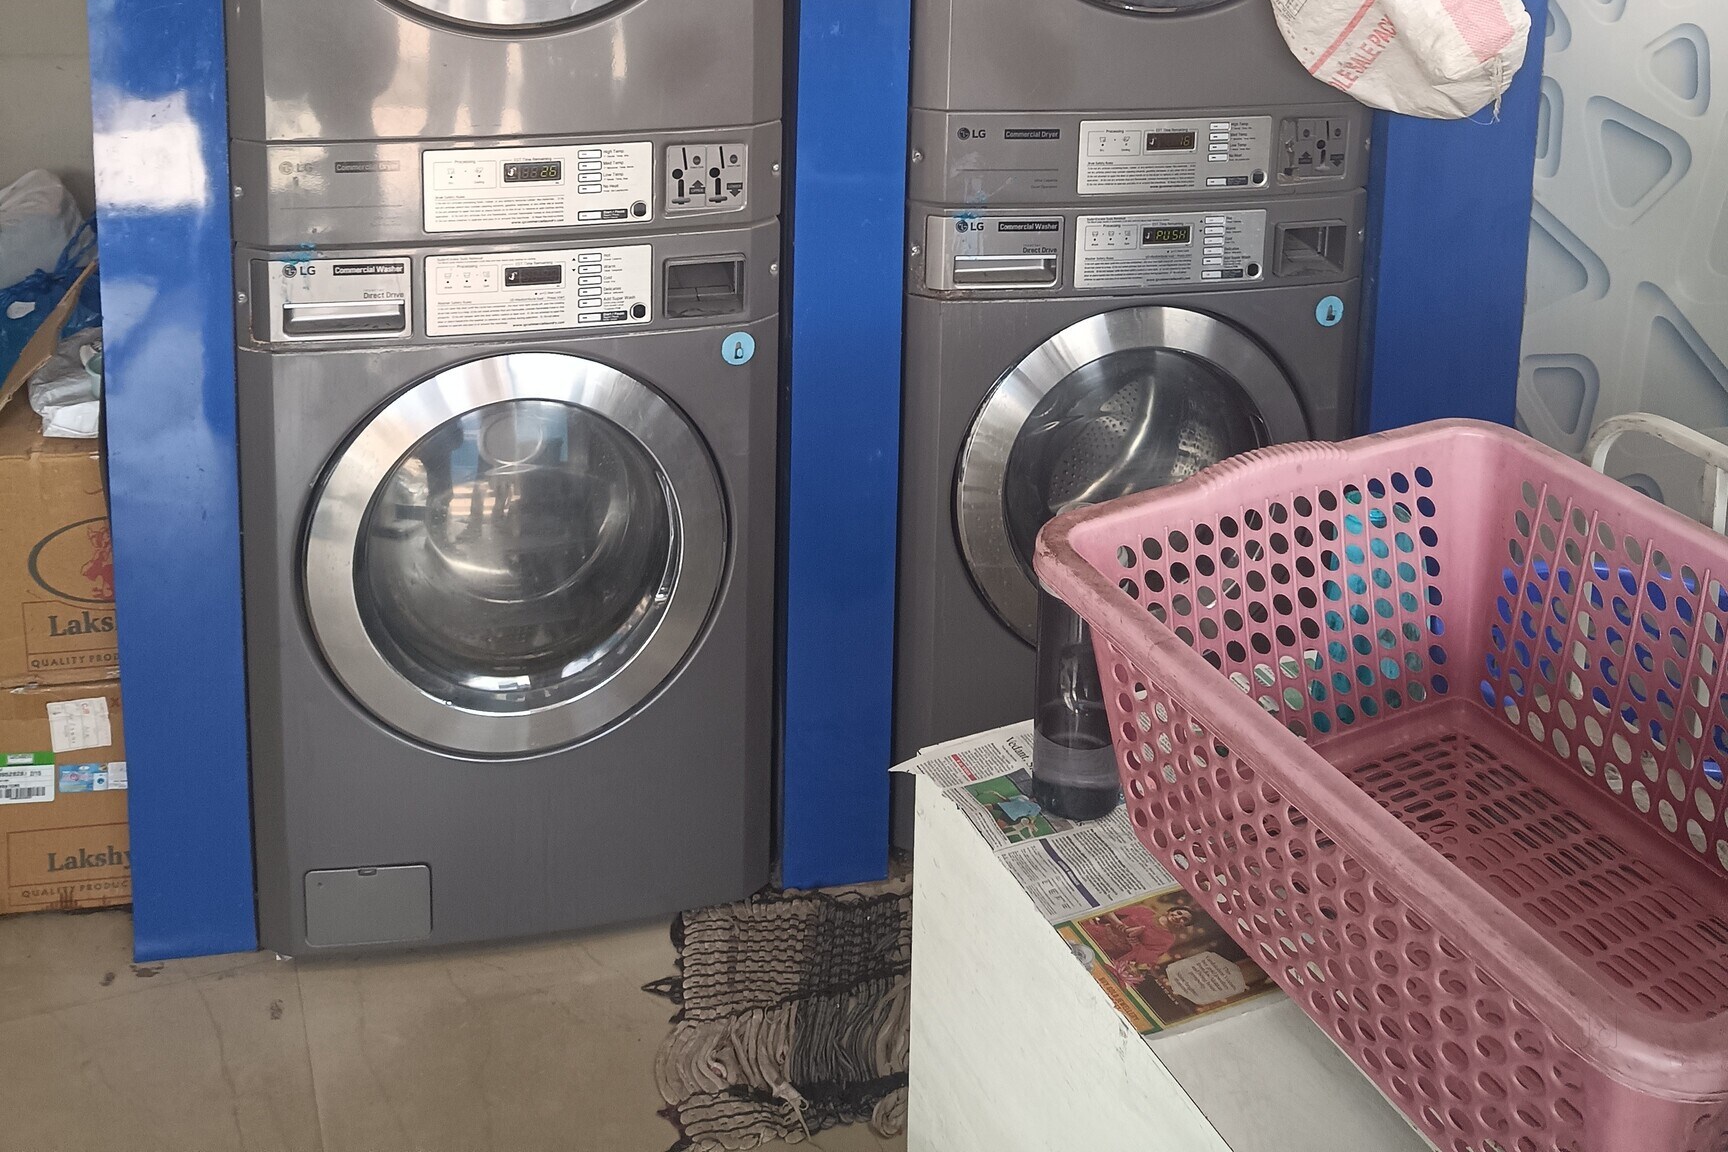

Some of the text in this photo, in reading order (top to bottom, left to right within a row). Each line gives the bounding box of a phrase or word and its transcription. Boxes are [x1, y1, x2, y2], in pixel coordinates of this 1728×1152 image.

[1344, 42, 1382, 74] SALE
[972, 129, 986, 138] LG
[1005, 130, 1059, 138] Commercial Dryer
[970, 222, 984, 231] LG
[1155, 229, 1187, 241] PUSH
[300, 266, 316, 276] LG
[334, 265, 404, 275] Commercial Washer
[386, 291, 405, 299] Drive
[48, 611, 117, 637] Laks
[31, 655, 85, 668] QUALITY
[21, 886, 75, 898] QUALITY
